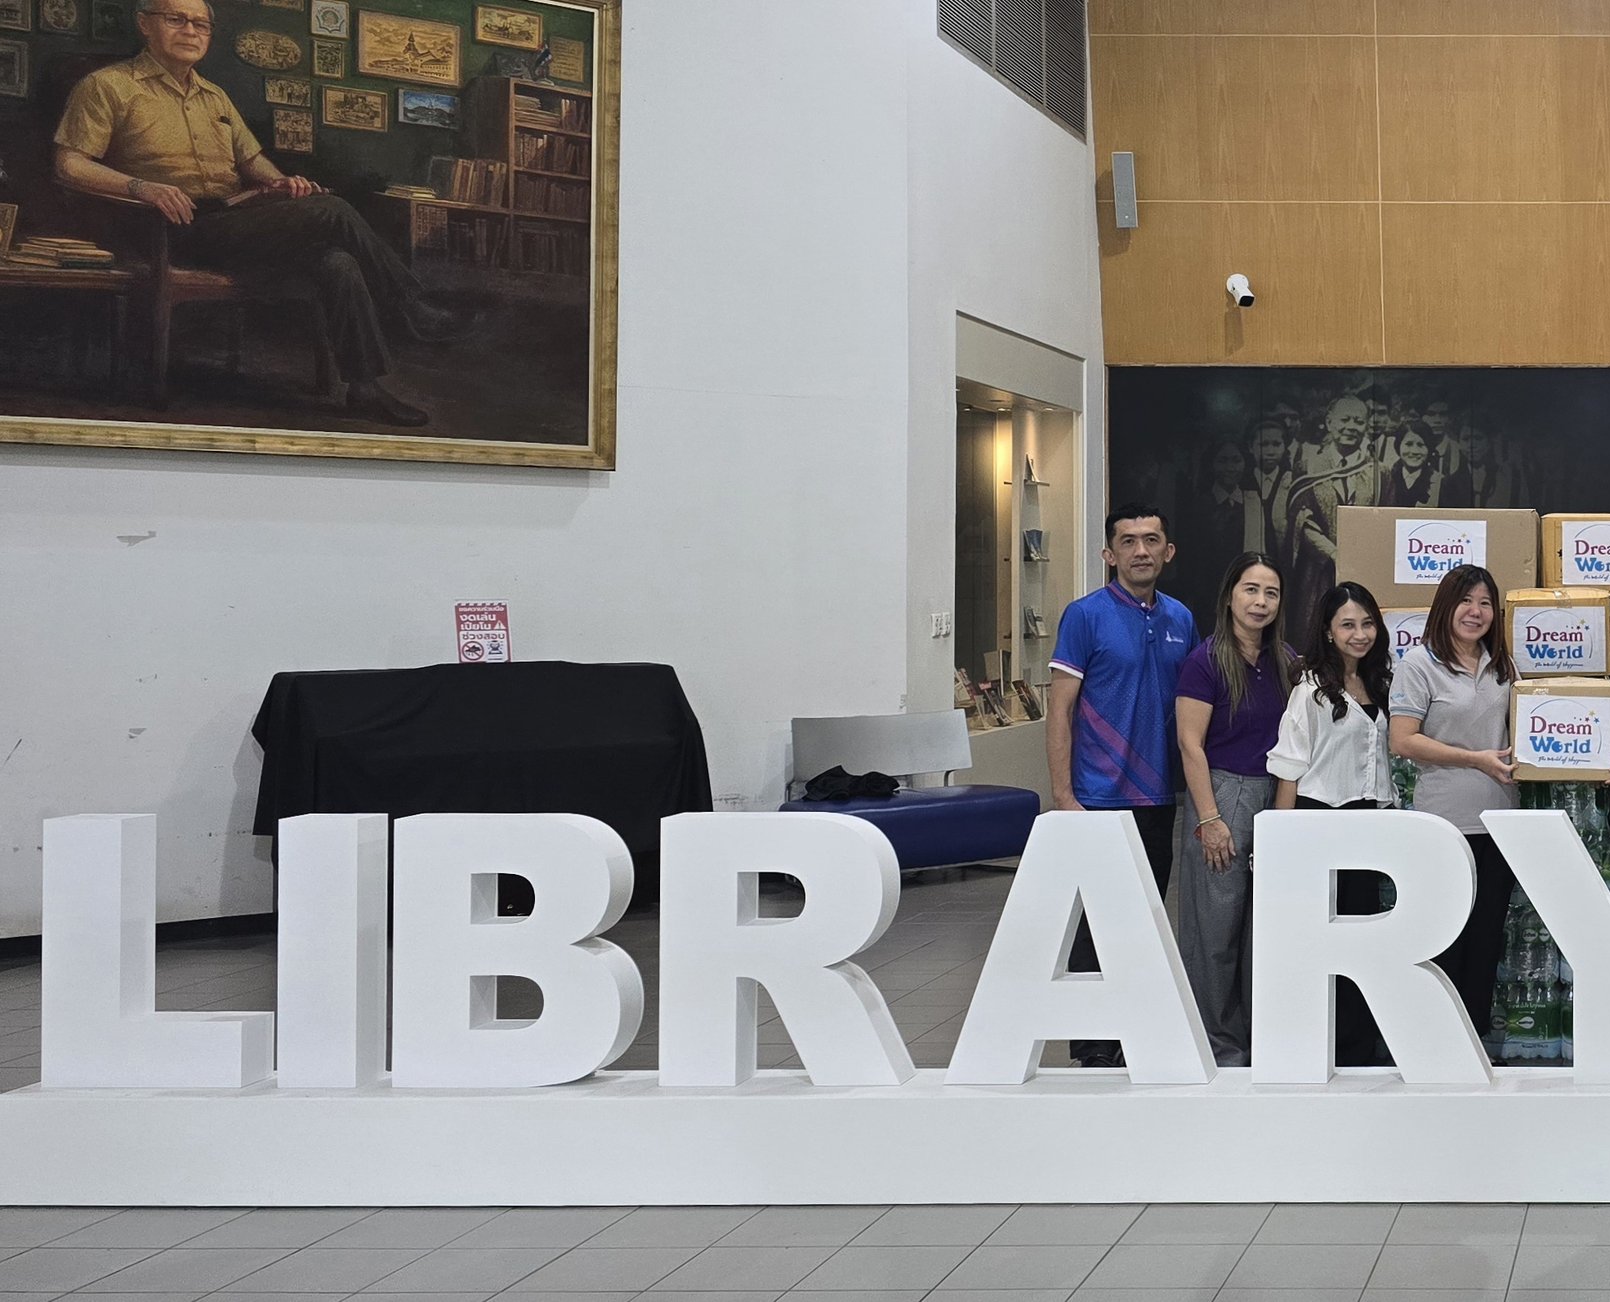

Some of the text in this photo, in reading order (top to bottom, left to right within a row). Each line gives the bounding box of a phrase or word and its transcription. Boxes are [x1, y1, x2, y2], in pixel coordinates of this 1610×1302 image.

[1408, 538, 1464, 555] Dream
[1407, 556, 1464, 572] World
[460, 612, 496, 621] งดเล่น
[460, 621, 491, 630] เปียโน
[1525, 625, 1584, 642] Dream
[462, 632, 505, 640] ช่วงสอบ
[1525, 644, 1584, 659] World
[1530, 715, 1592, 735] Dream
[1529, 735, 1591, 754] World
